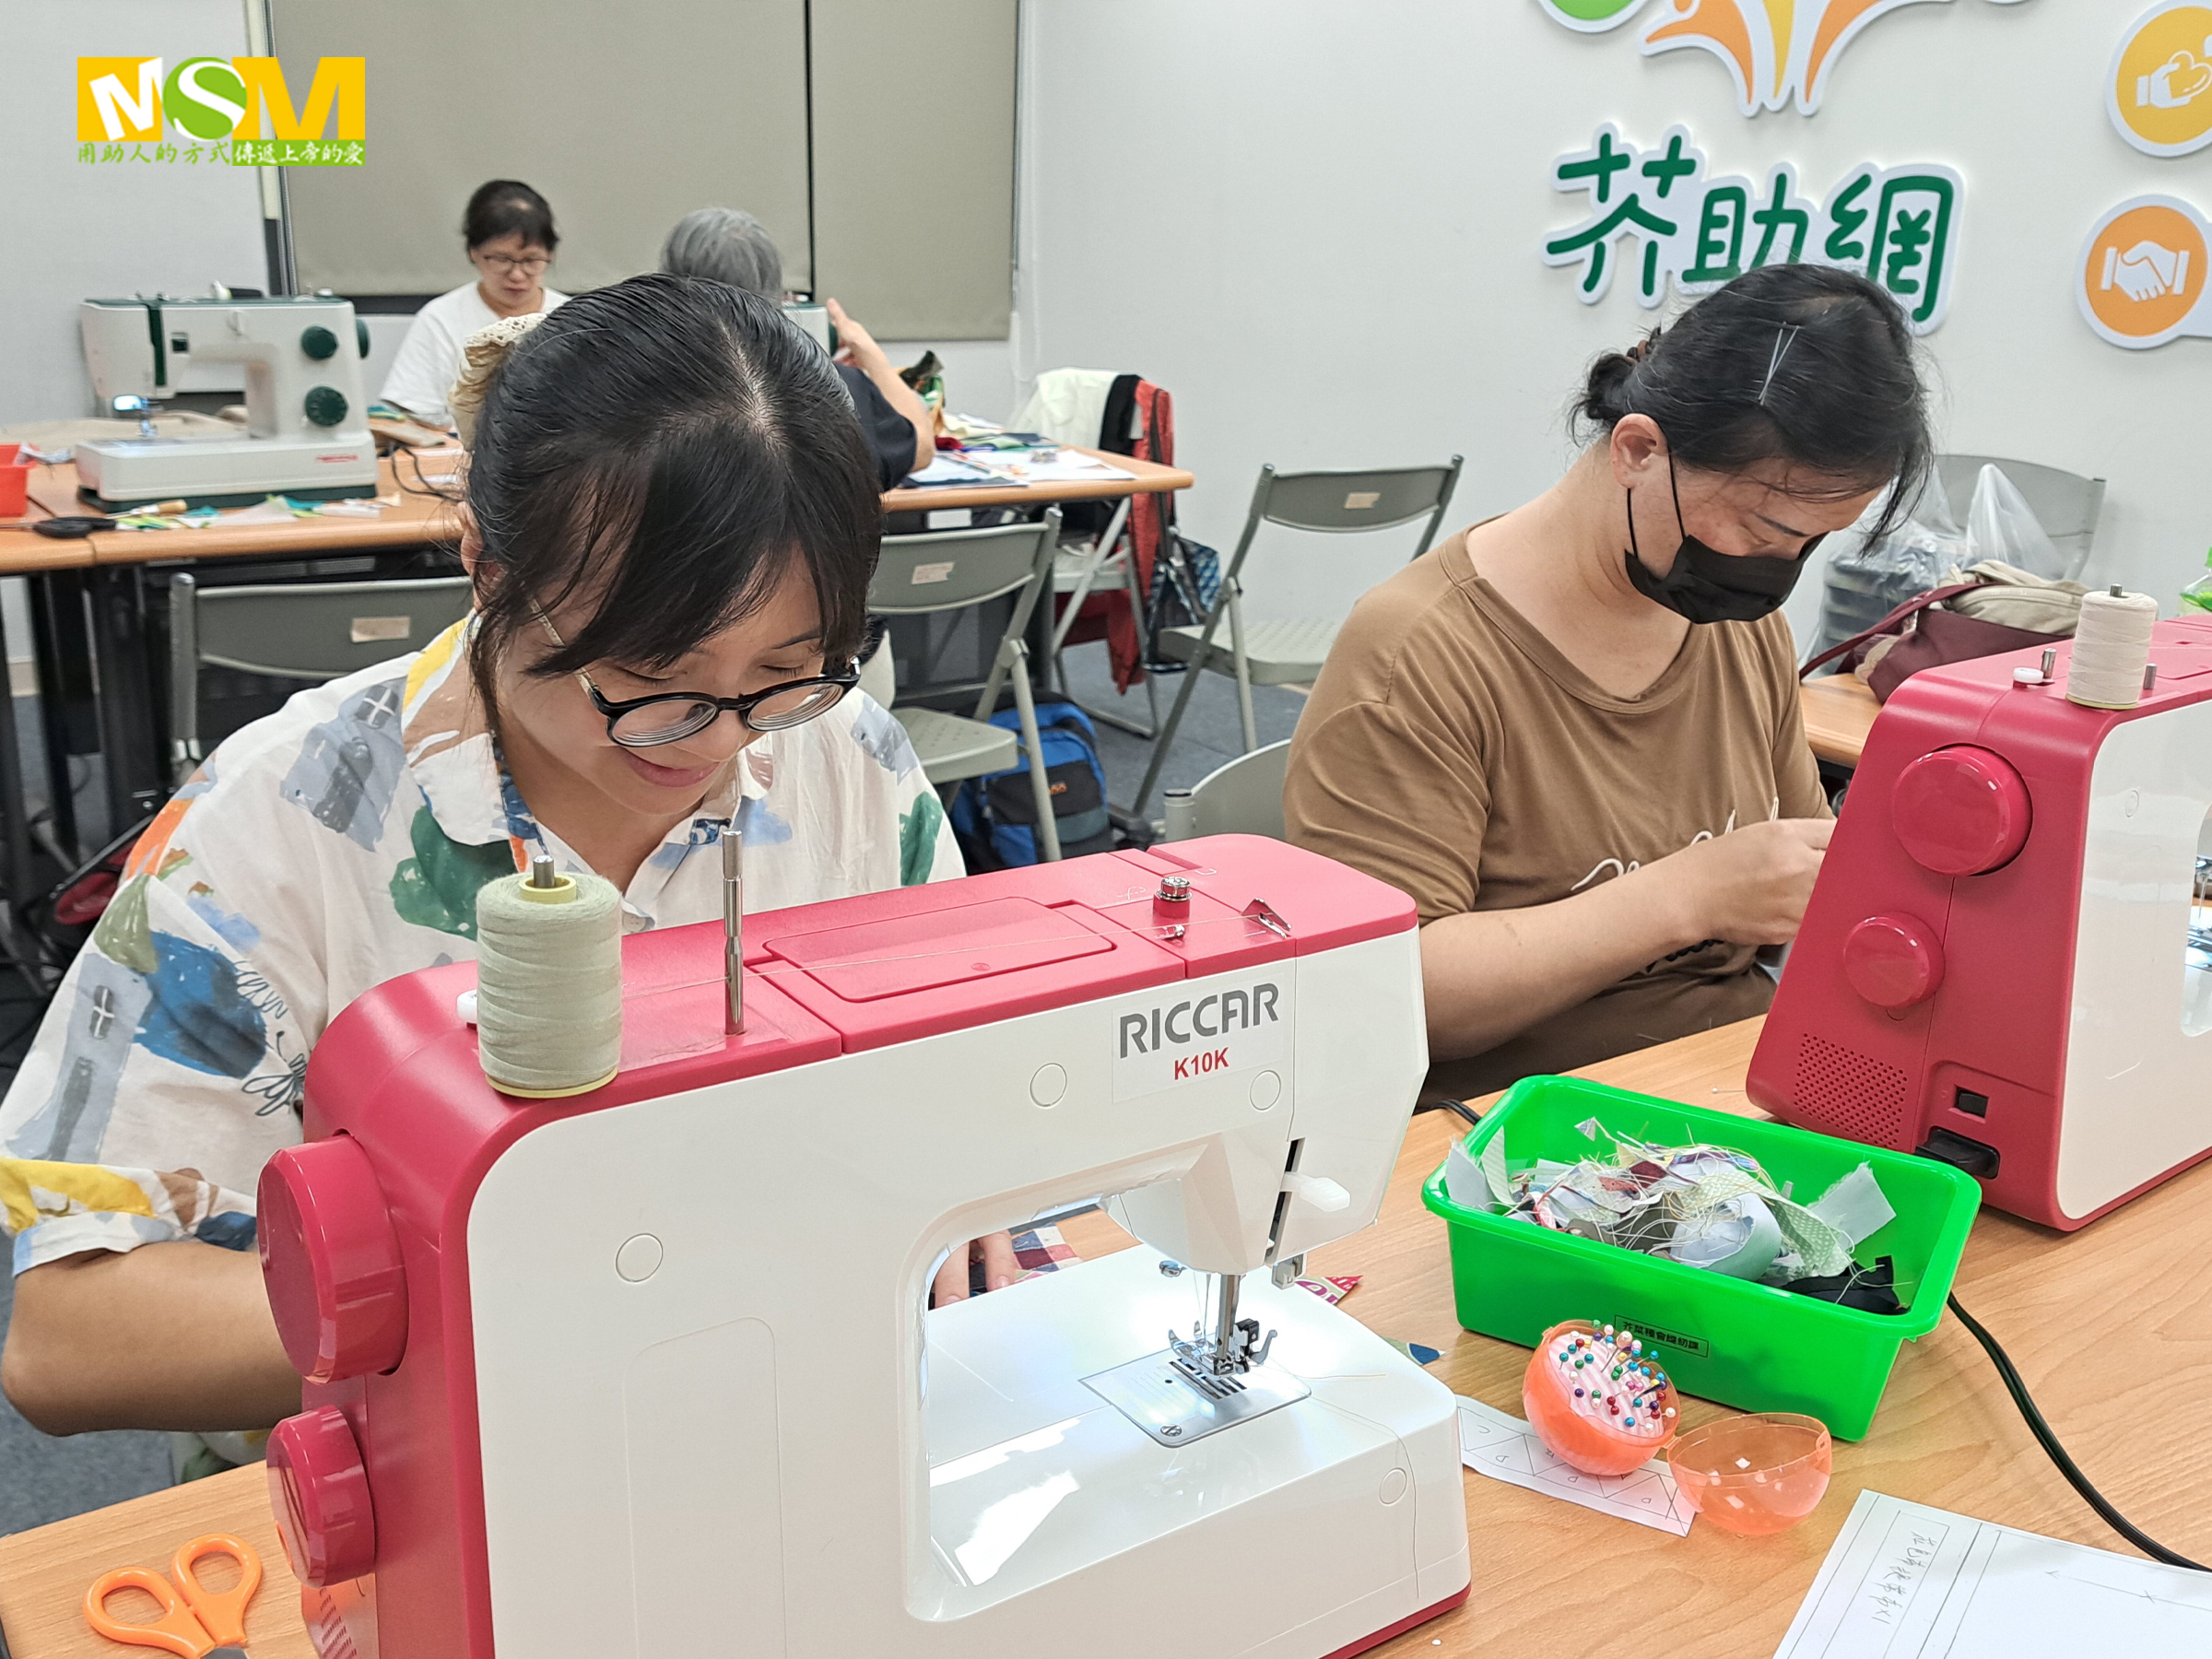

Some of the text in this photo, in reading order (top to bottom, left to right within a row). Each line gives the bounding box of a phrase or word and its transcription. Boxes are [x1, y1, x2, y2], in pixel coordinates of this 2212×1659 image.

[1547, 133, 1954, 323] 芥助網
[1120, 982, 1279, 1059] RICCAR
[1174, 1047, 1230, 1080] K10K
